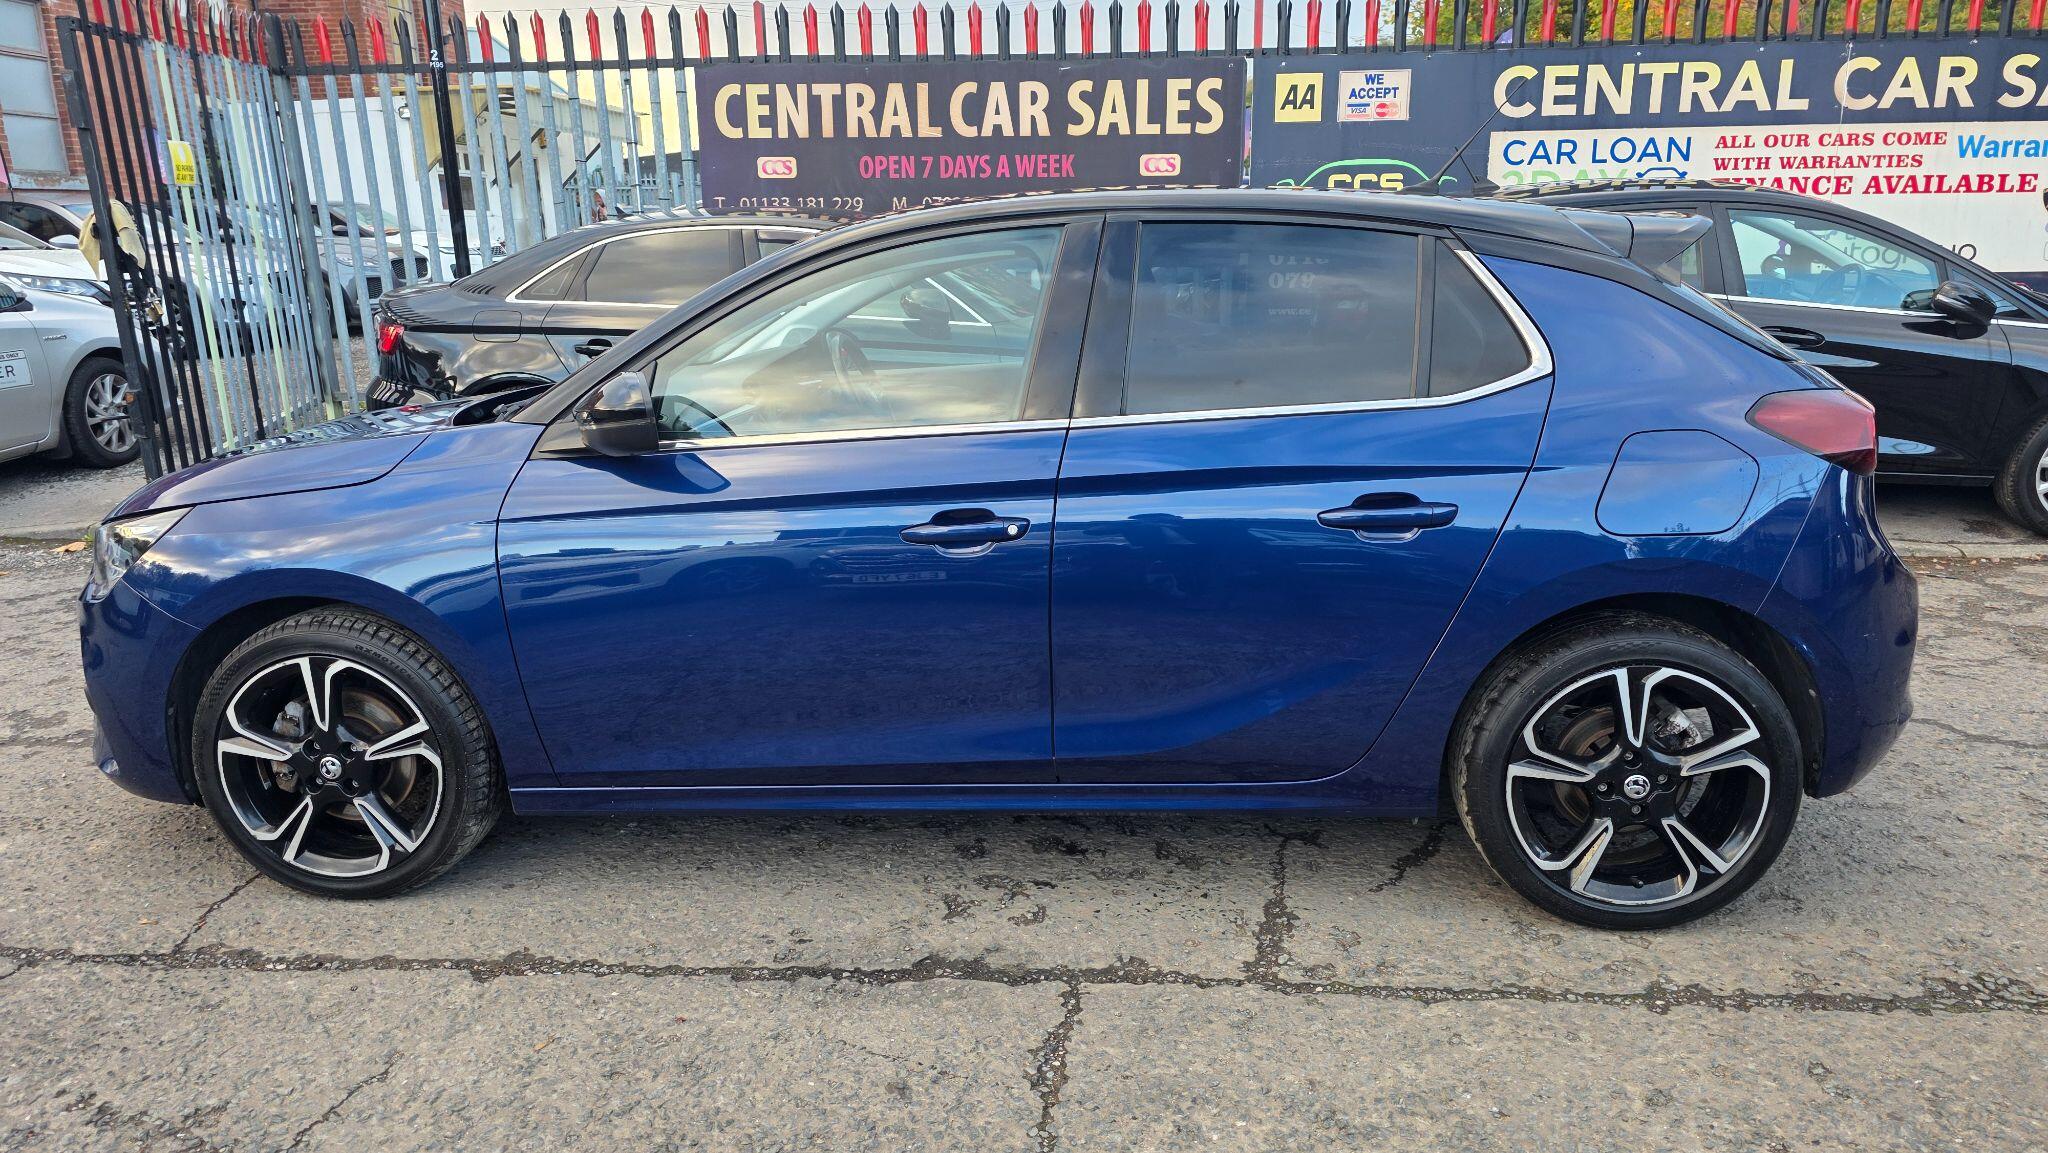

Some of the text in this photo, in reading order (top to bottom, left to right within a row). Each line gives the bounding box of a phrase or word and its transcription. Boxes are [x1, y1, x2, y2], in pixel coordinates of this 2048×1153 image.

[431, 49, 439, 61] 2
[1364, 73, 1385, 85] WE
[1493, 53, 2048, 119] CENTRAL CAR S
[1280, 84, 1316, 111] AA
[1348, 87, 1400, 100] ACCEPT
[714, 77, 1224, 139] CENTRAL CAR SALES
[1714, 131, 1948, 149] ALL OUR CARS COME
[1502, 136, 1692, 166] CAR LOAN
[858, 154, 1076, 179] OPEN 7 DAYS A WEEK
[1712, 154, 1924, 171] WITH WARRANTIES
[1861, 173, 2039, 195] AVAILABLE
[740, 196, 790, 208] 01133
[797, 196, 824, 208] 181
[831, 196, 865, 212] 229
